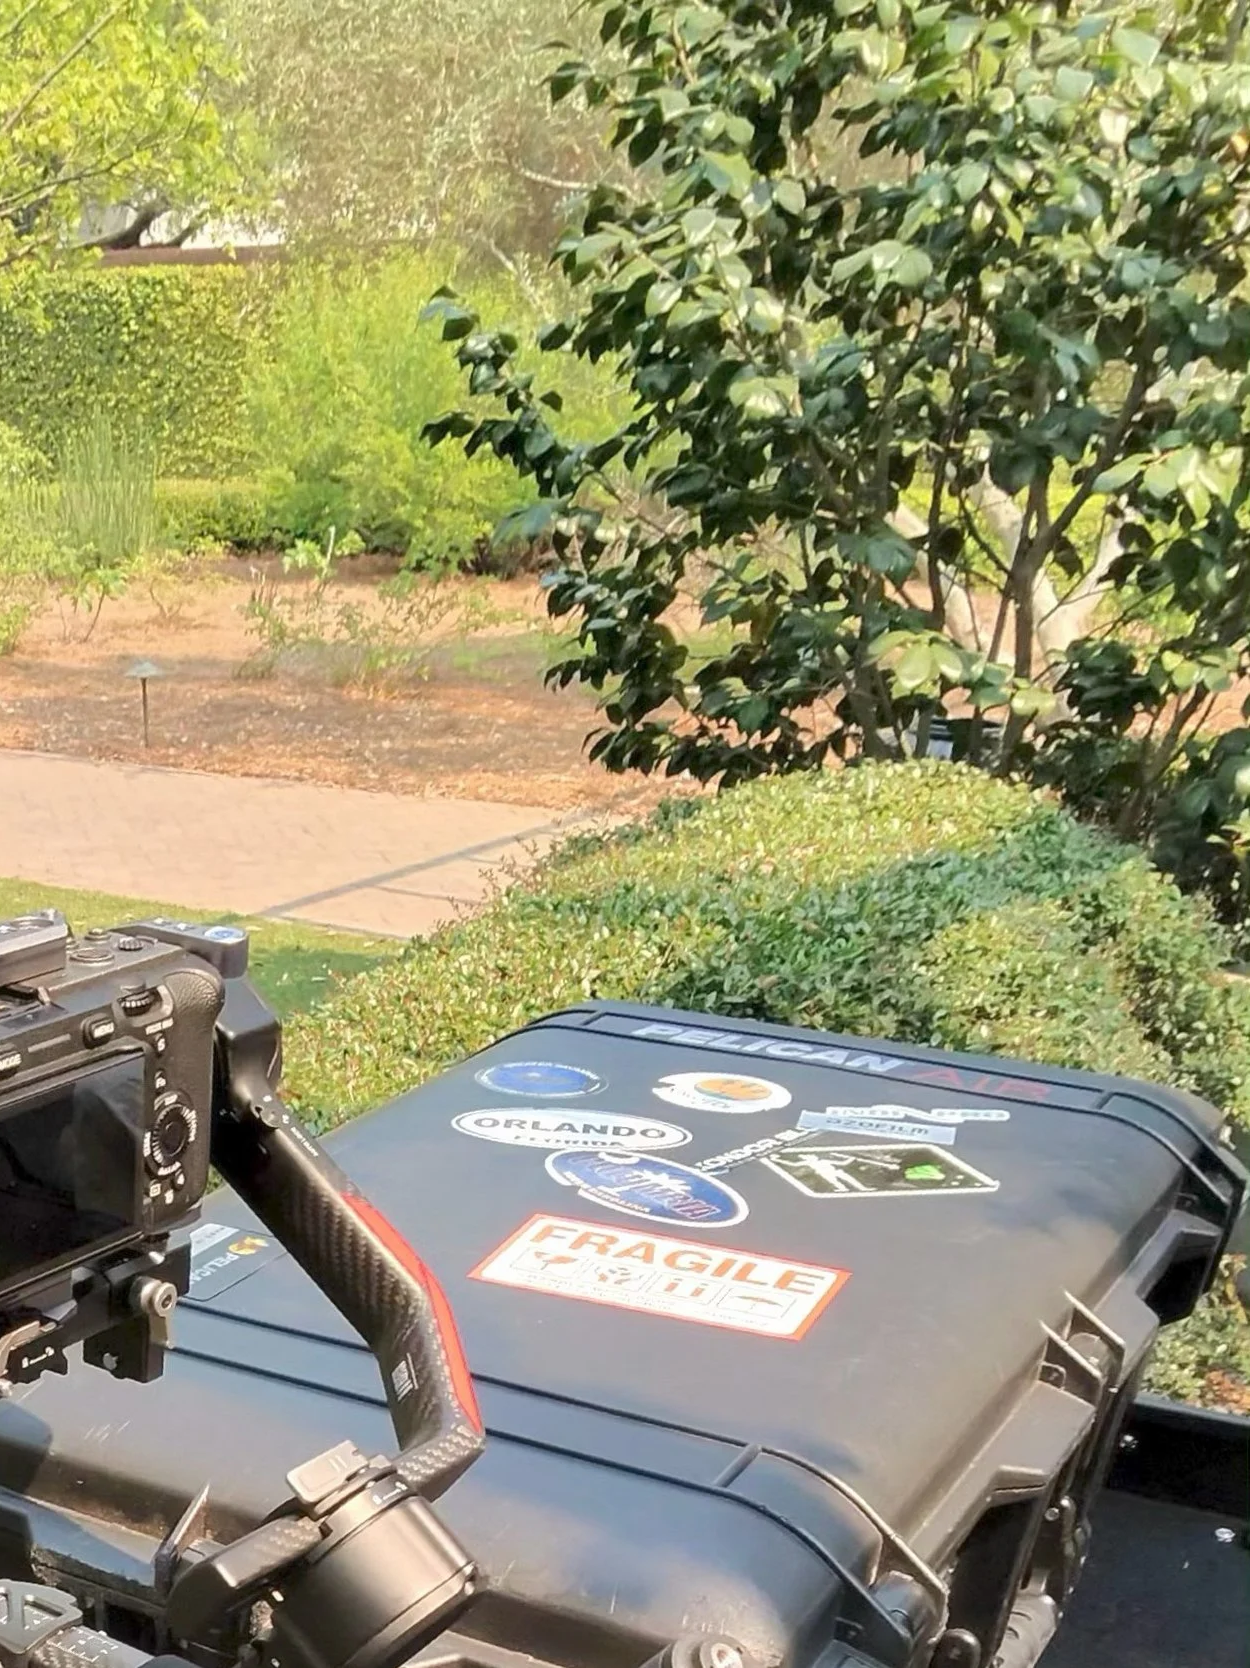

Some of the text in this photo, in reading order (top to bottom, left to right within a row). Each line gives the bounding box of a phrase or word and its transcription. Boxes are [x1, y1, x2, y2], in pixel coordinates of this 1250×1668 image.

[0, 1054, 22, 1070] MODE
[632, 1023, 906, 1072] PELICAN
[909, 1067, 1050, 1101] AIR
[473, 1117, 667, 1140] ORLANDO
[190, 1251, 240, 1285] PELICA
[530, 1225, 826, 1295] FRAGILE
